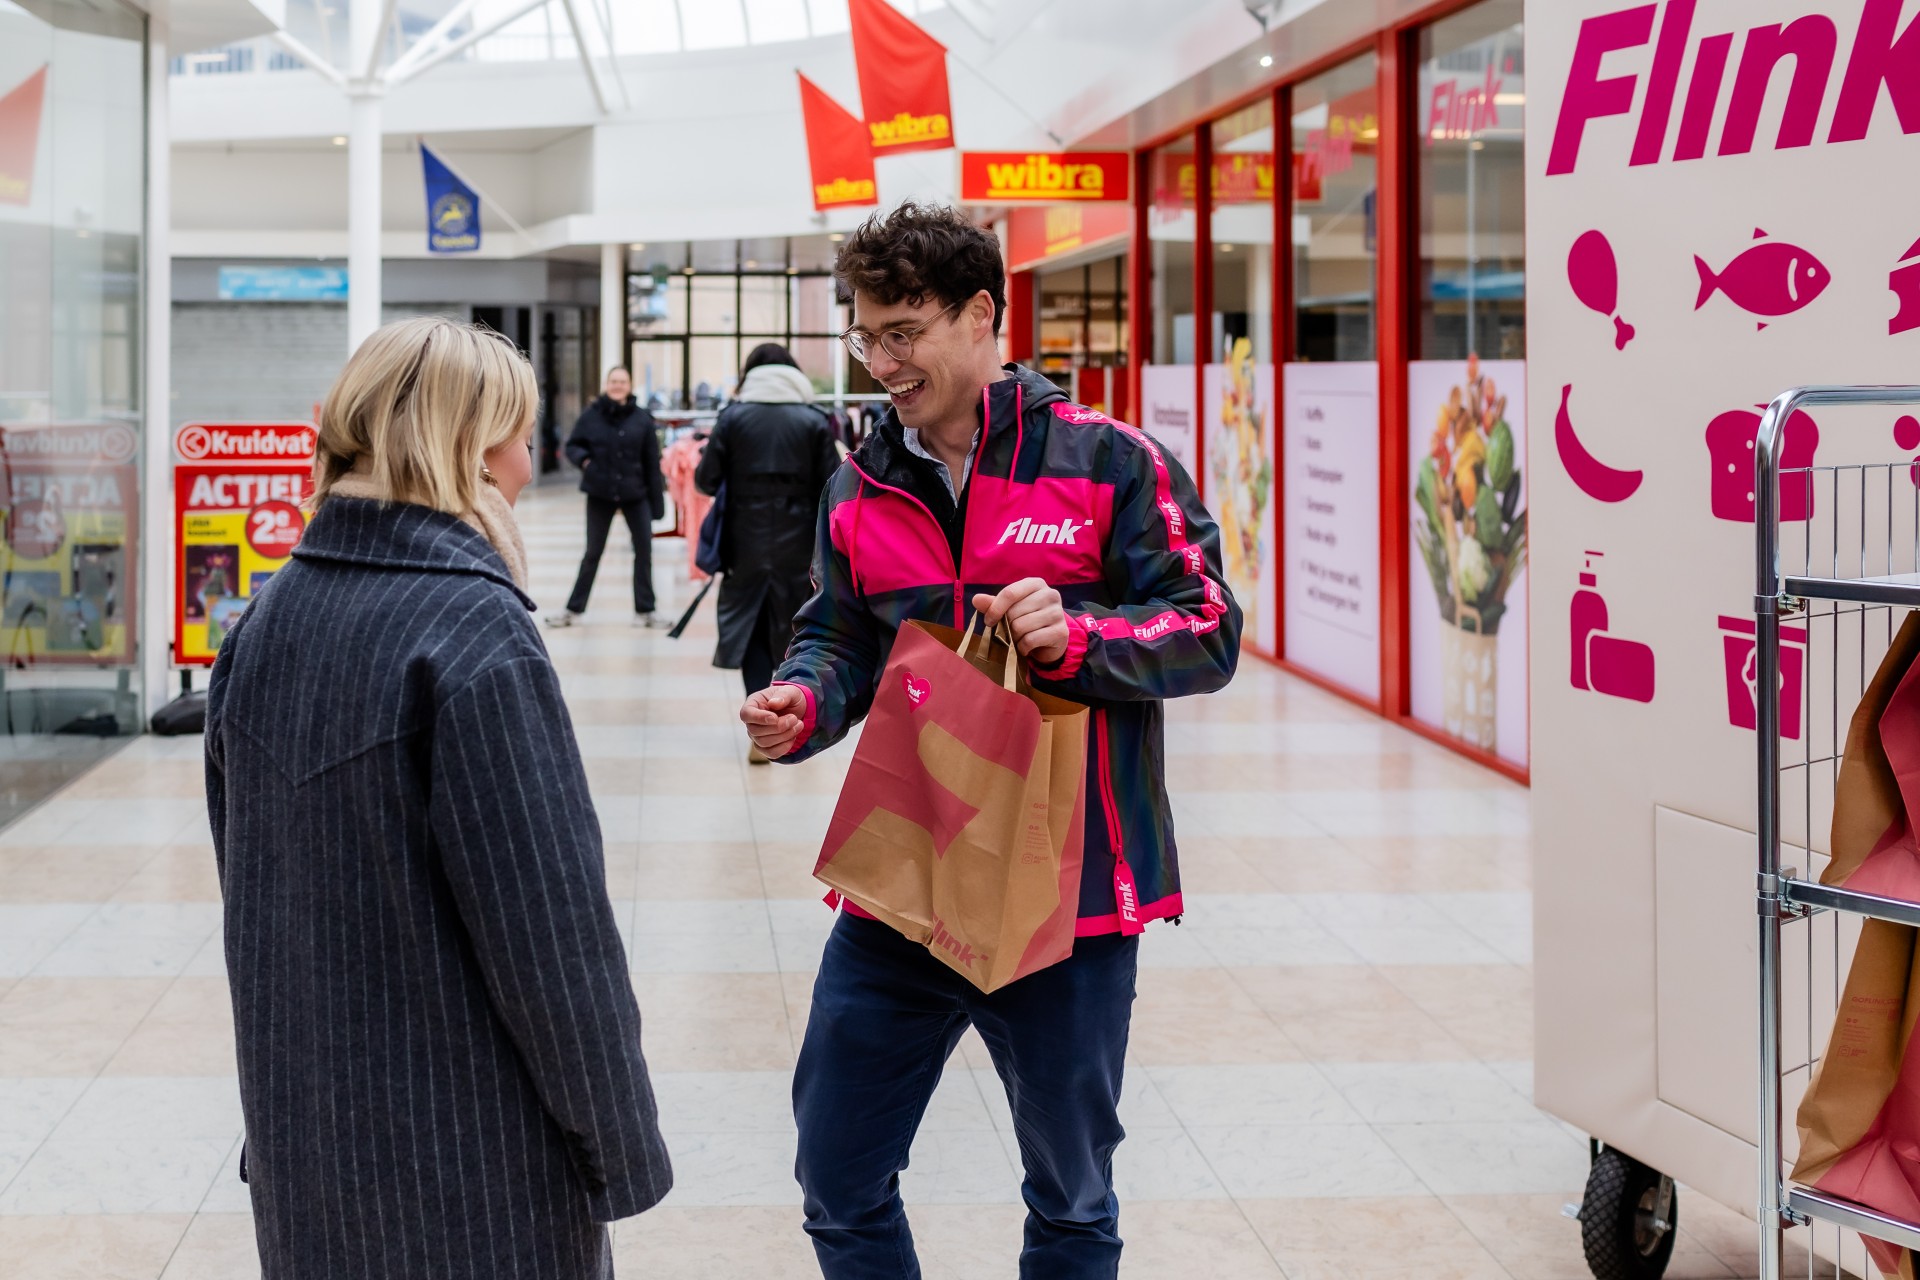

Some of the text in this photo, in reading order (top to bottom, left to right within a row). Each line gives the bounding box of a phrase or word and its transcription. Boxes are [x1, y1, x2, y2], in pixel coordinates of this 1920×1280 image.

[1545, 0, 1920, 176] Flink
[869, 112, 949, 141] wibra
[986, 154, 1105, 189] wibra
[815, 177, 874, 201] wibra
[211, 429, 312, 455] Kruidvat
[188, 474, 303, 507] ACTIE!
[997, 517, 1083, 545] Flink
[1162, 501, 1182, 536] Flink
[1134, 618, 1170, 638] Flink
[1118, 881, 1138, 922] Flink
